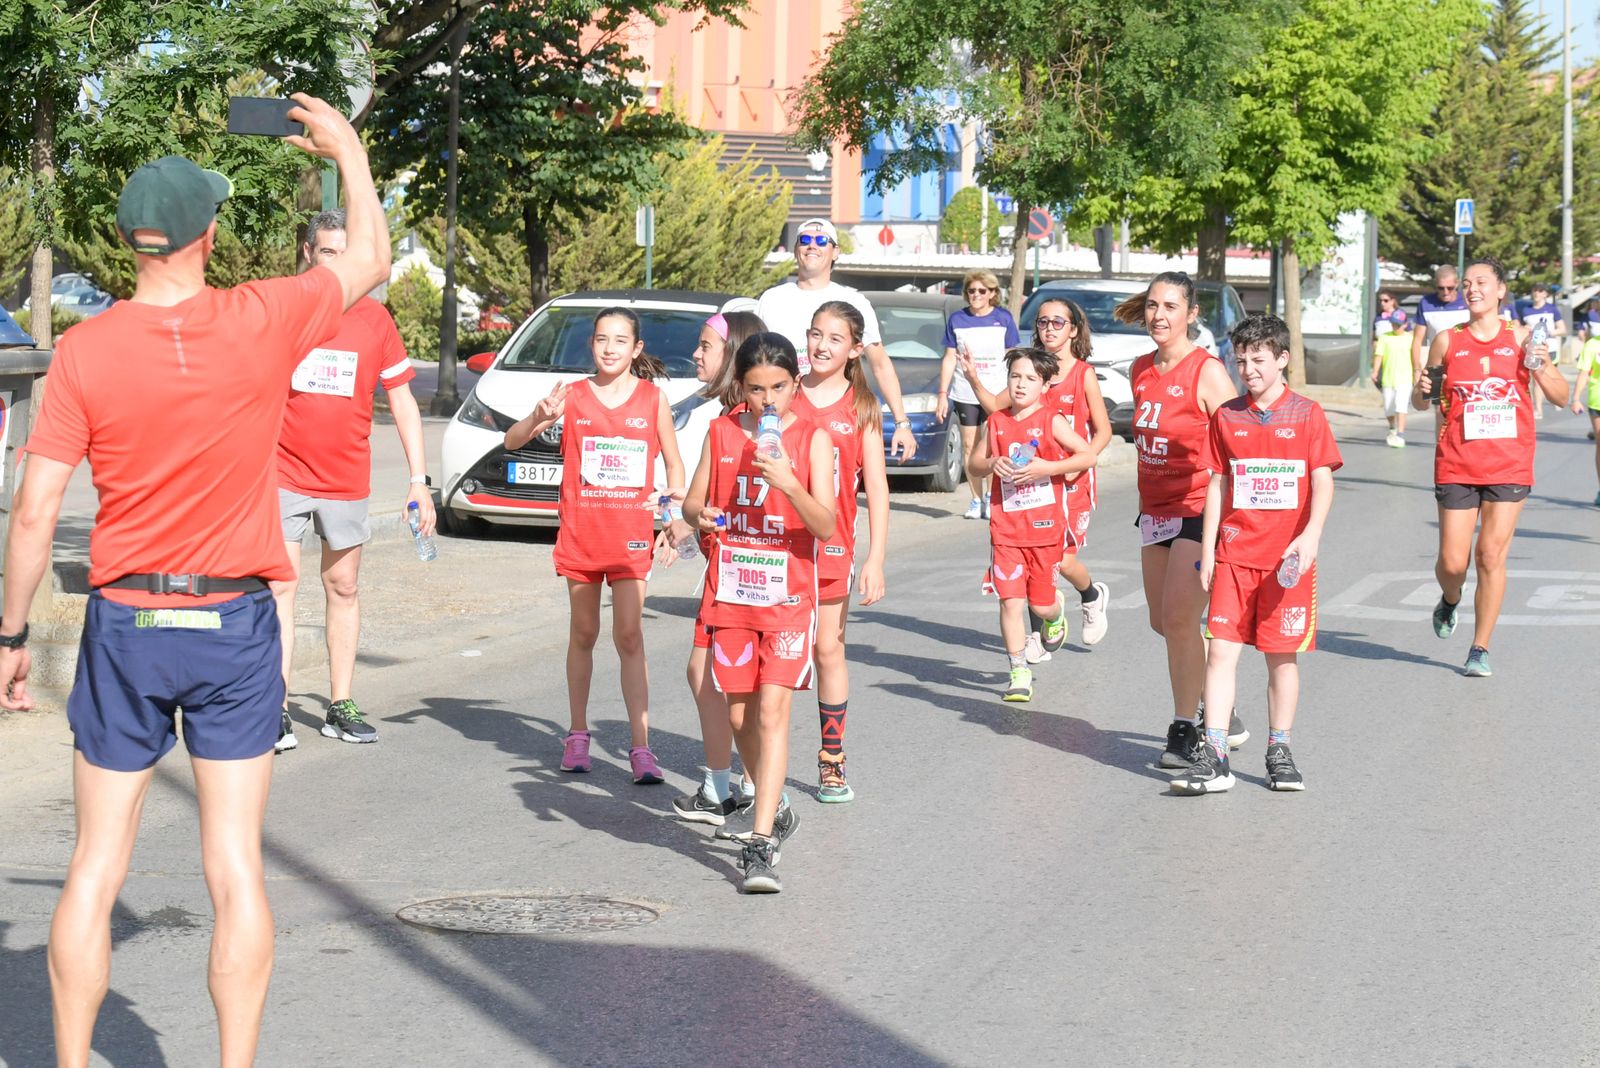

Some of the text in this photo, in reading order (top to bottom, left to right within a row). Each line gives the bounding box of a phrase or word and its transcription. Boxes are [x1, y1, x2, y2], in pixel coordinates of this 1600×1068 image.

[1479, 356, 1490, 375] 1
[317, 383, 339, 391] vithas
[1135, 401, 1162, 430] 21
[1480, 414, 1501, 424] 7567
[600, 454, 628, 468] 765
[518, 466, 557, 481] 3817
[736, 475, 770, 507] 17
[1014, 482, 1037, 496] 7521
[1251, 477, 1279, 491] 7523
[737, 567, 767, 586] 7805
[745, 591, 770, 601] vithas
